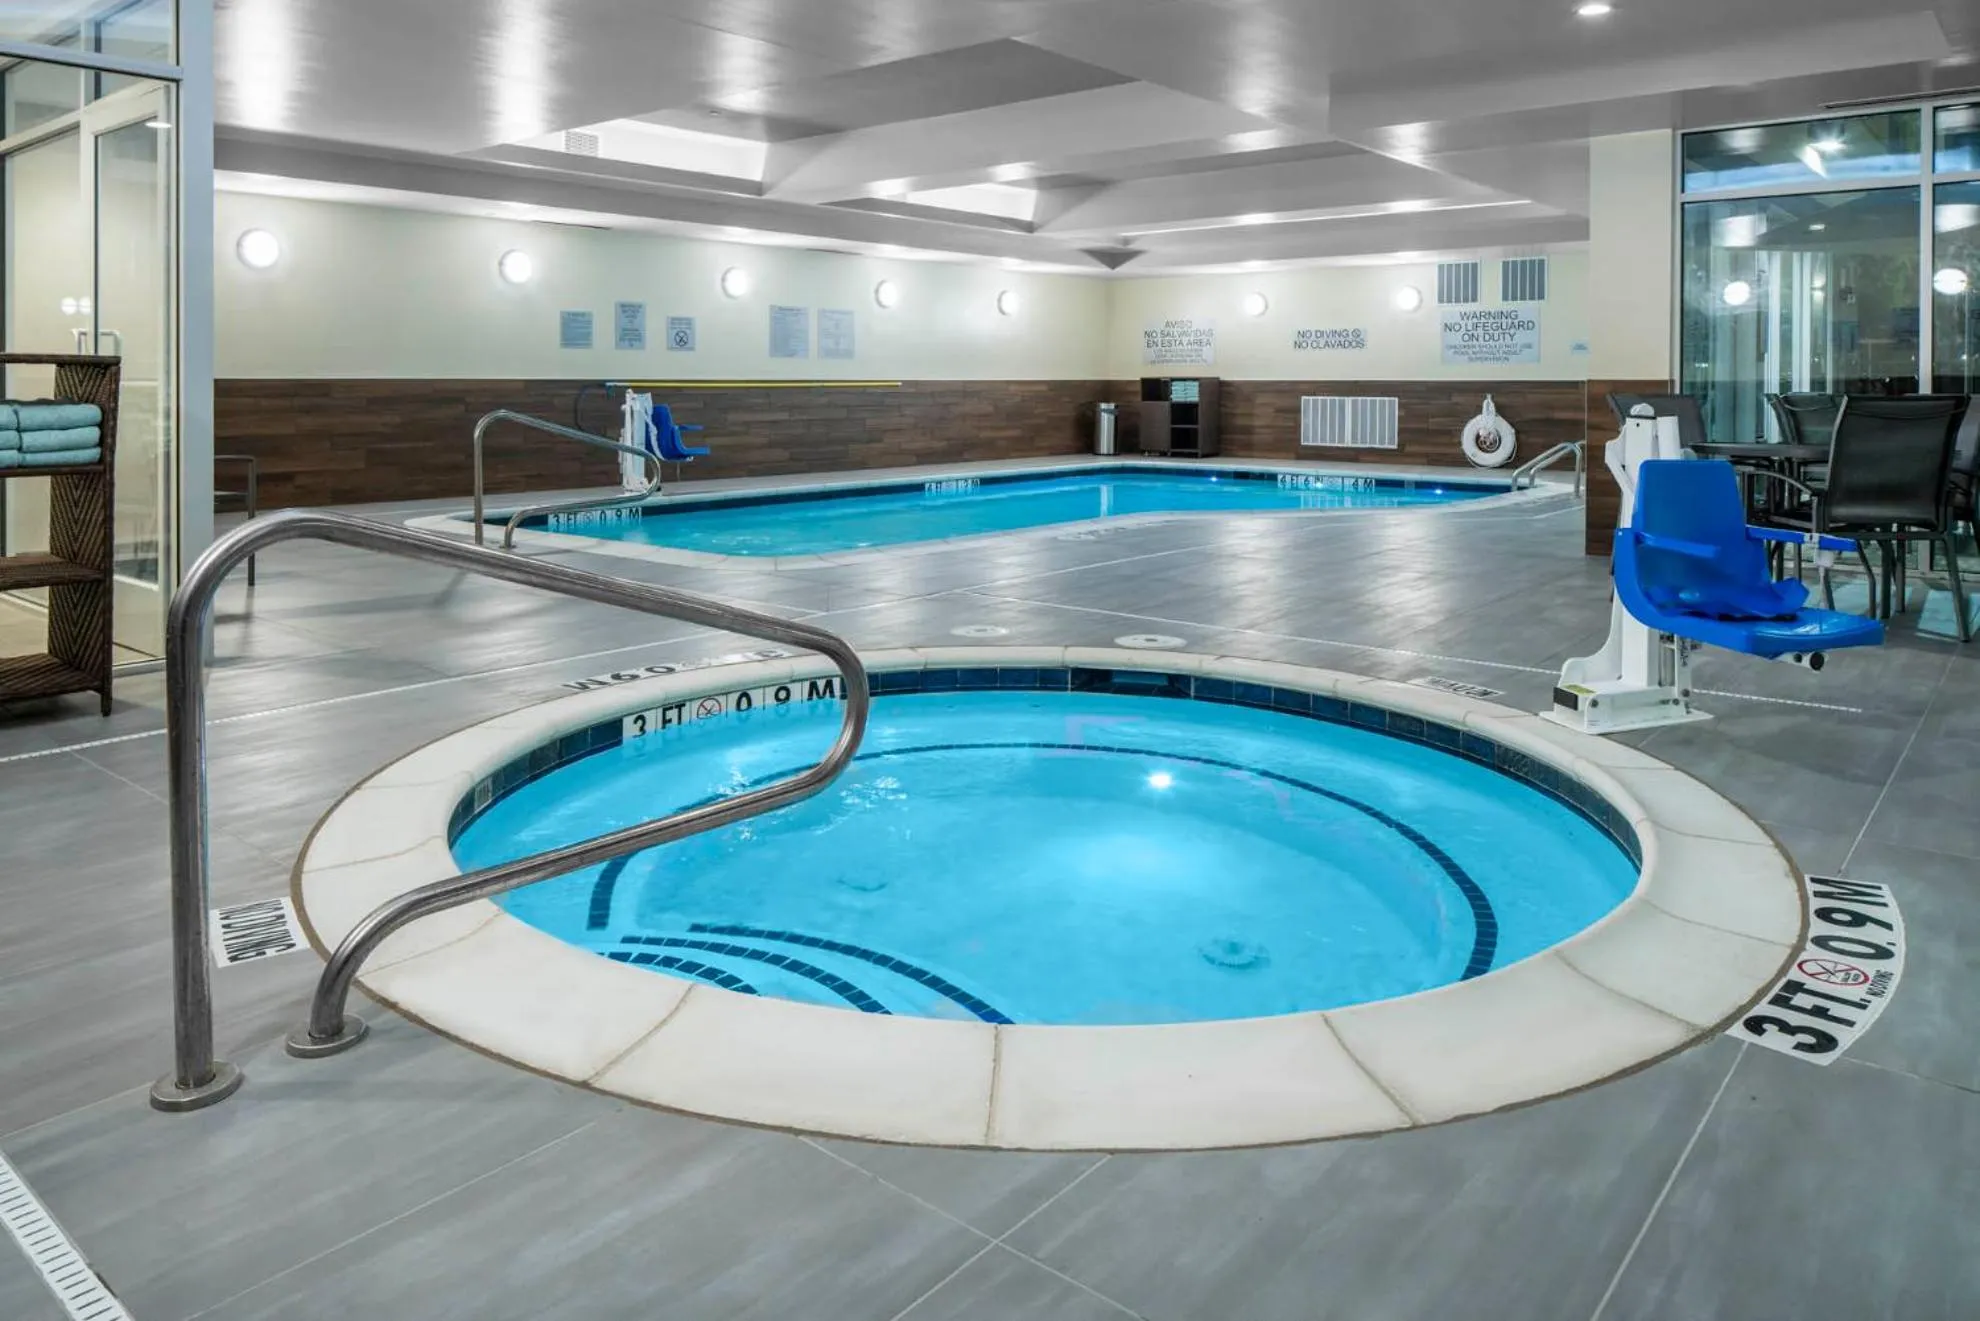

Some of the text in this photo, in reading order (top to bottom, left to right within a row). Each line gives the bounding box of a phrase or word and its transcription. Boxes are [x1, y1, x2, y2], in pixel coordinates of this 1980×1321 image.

[1460, 310, 1518, 321] WARNING
[1444, 320, 1535, 332] NO LIFEGUARD
[1144, 330, 1158, 339] NO
[1297, 329, 1349, 339] NO DIVING
[1462, 332, 1517, 343] ON DUTY
[1147, 339, 1159, 348] EN
[1161, 339, 1184, 348] ESTA
[1294, 340, 1365, 349] NO CLAVADOS
[632, 714, 647, 738] 3
[662, 703, 686, 729] FT
